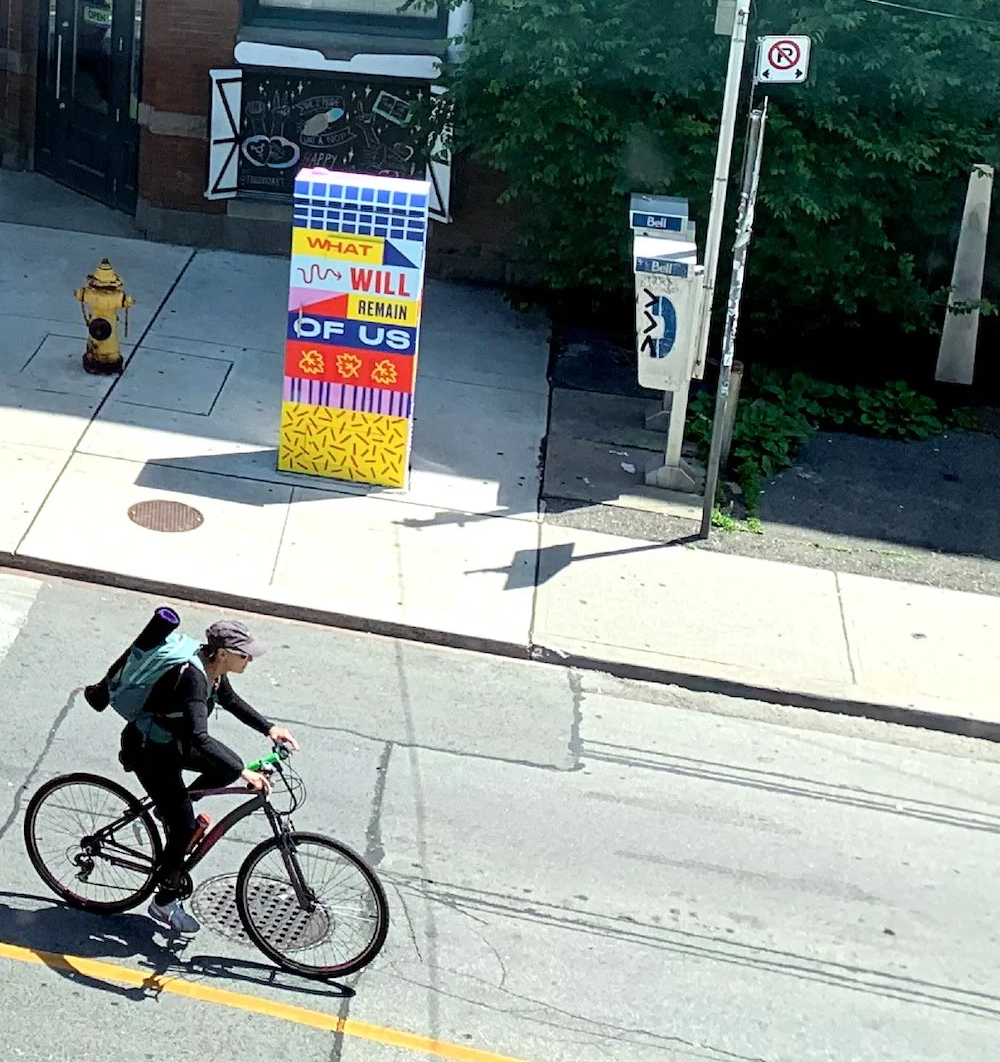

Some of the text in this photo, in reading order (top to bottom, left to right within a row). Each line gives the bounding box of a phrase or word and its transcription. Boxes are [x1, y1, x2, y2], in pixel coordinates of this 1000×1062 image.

[646, 216, 667, 229] Bell
[306, 236, 373, 257] WHAT
[651, 260, 673, 274] Bell
[349, 267, 411, 298] WILL
[357, 299, 408, 321] REMAIN
[292, 316, 411, 350] OF US
